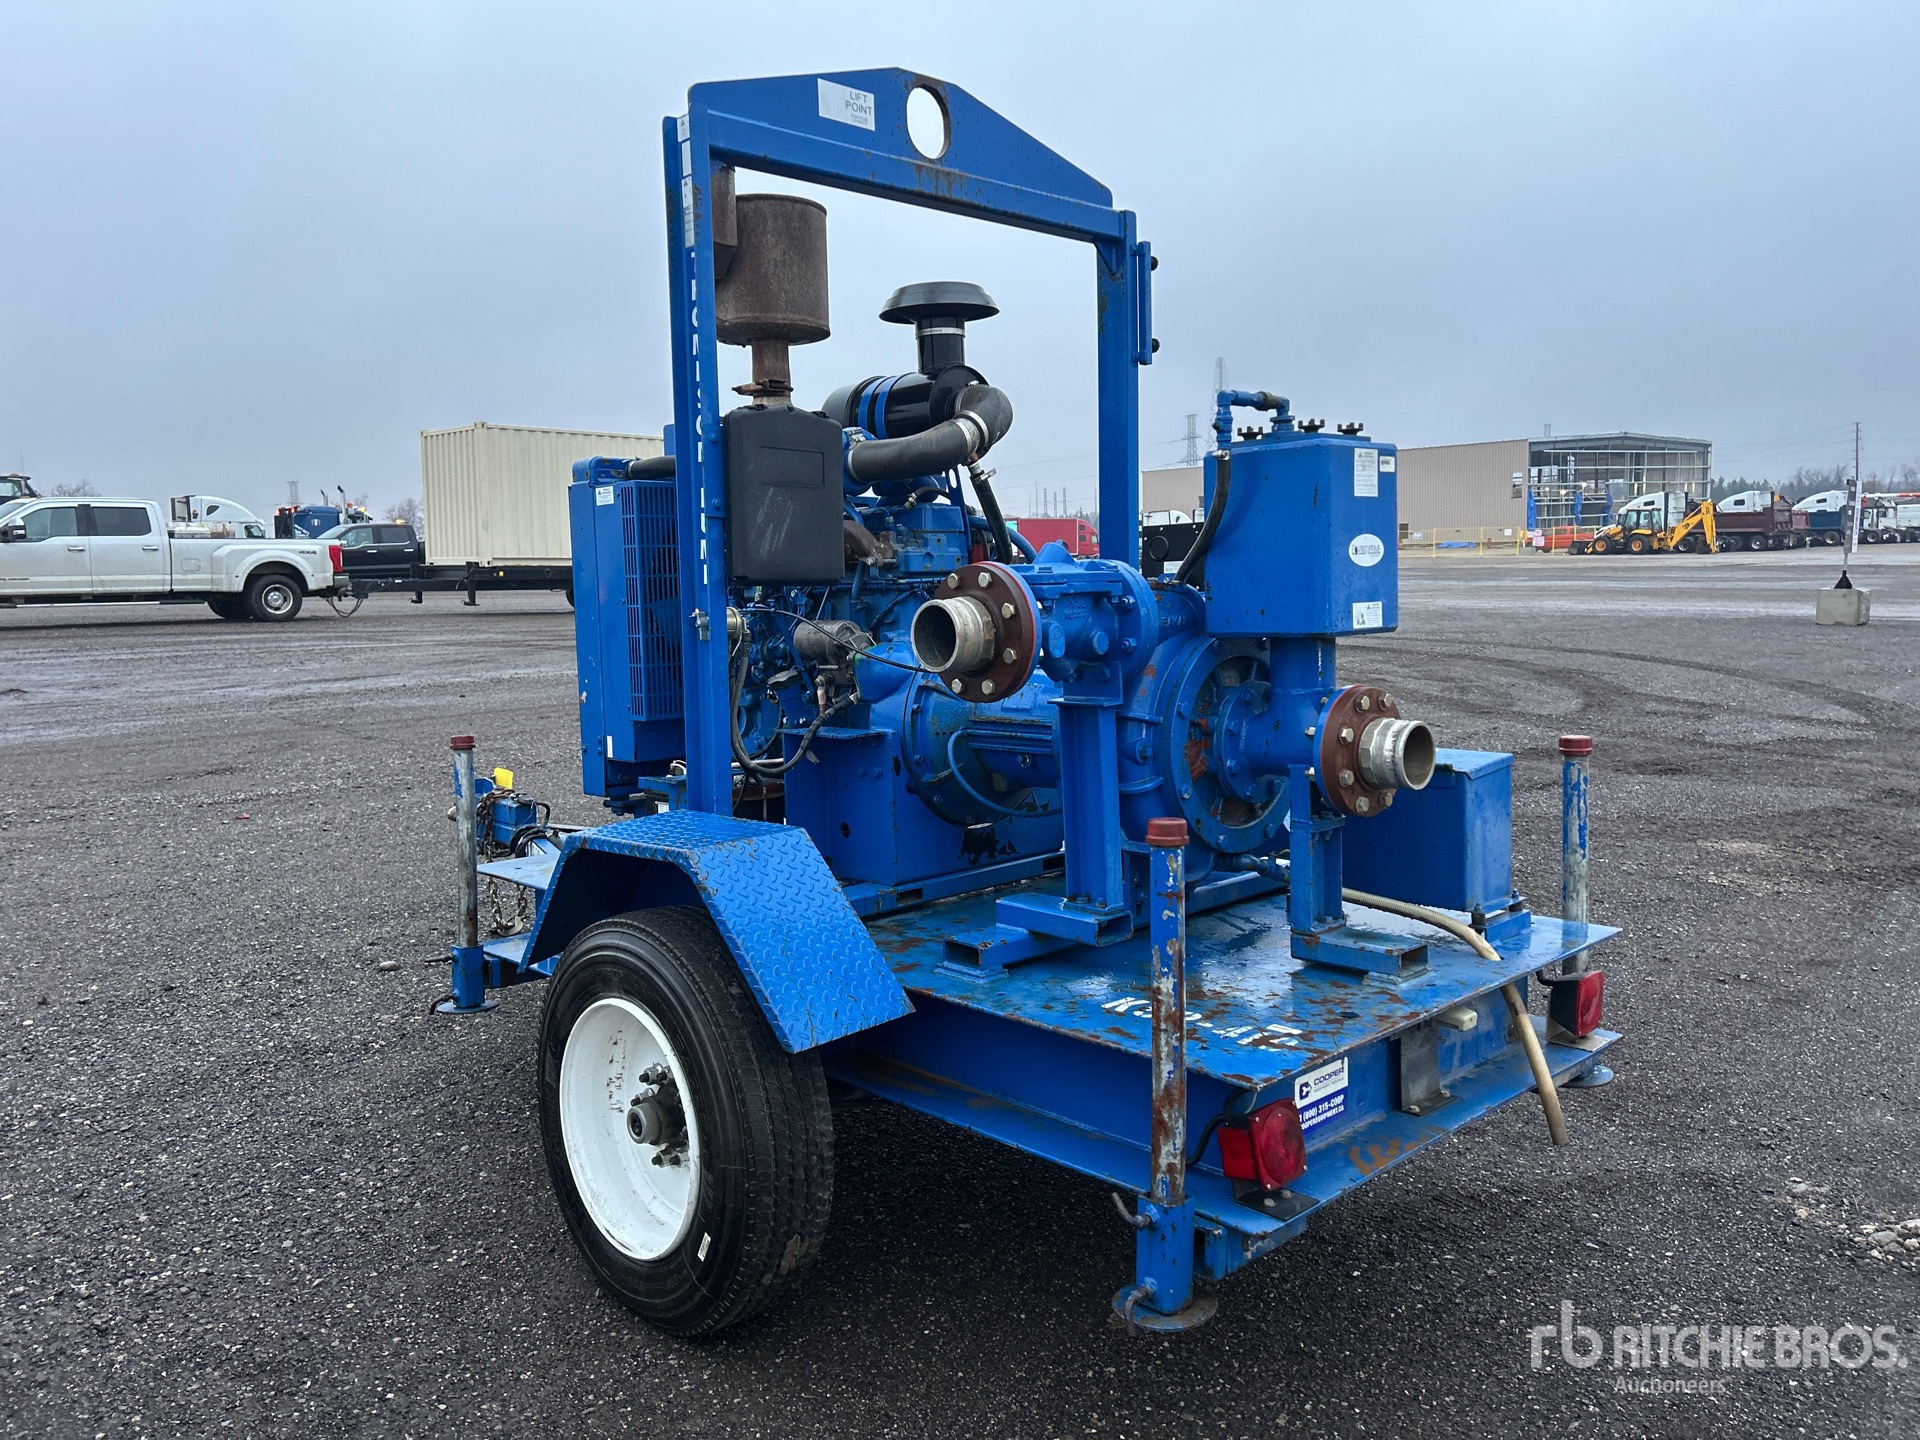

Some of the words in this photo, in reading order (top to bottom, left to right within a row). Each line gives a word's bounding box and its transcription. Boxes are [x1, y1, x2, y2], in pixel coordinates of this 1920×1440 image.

[849, 90, 868, 103] LIFT
[845, 100, 873, 115] POINT
[1313, 1067, 1345, 1086] COOPER
[1318, 1094, 1345, 1114] 315-COOP
